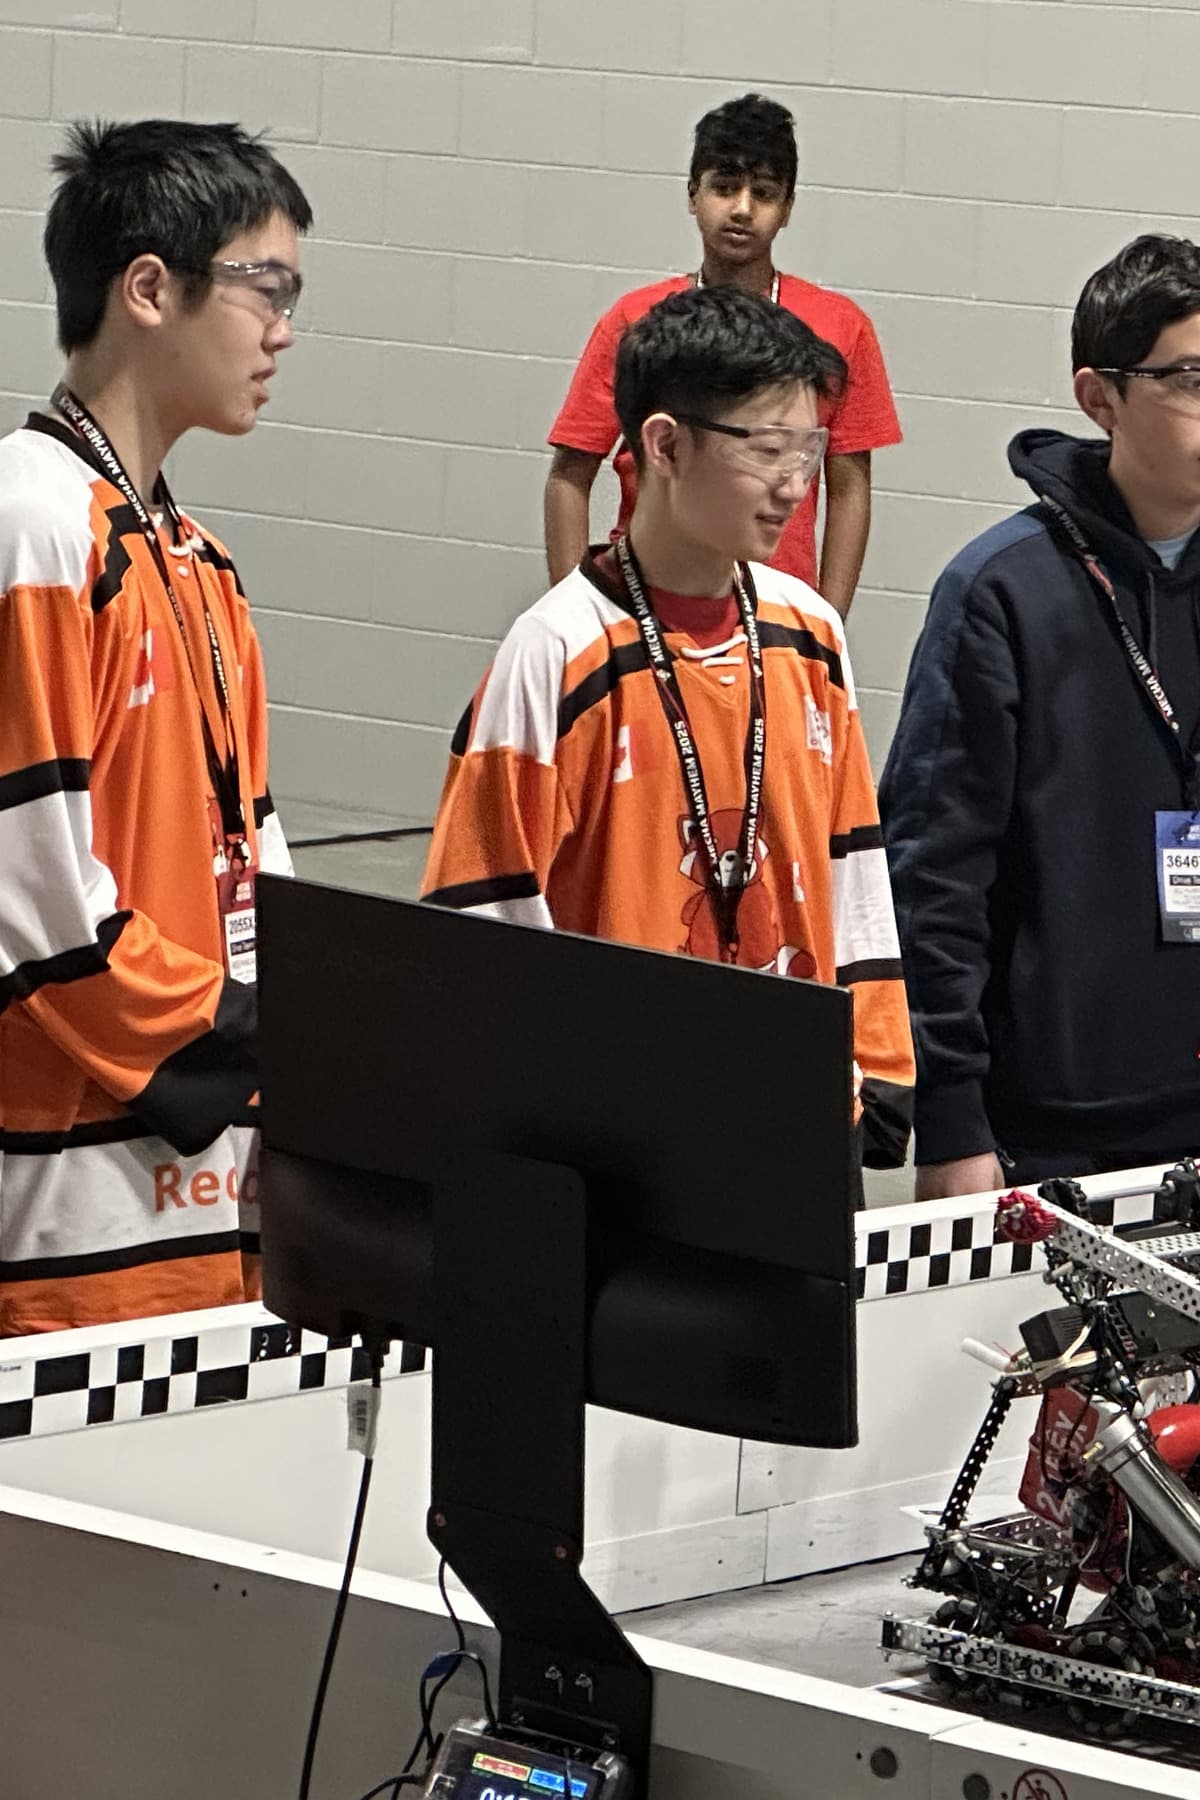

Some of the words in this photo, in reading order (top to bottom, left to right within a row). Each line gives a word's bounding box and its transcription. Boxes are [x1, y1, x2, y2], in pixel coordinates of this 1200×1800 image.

[79, 418, 121, 474] MAYHEM
[117, 475, 148, 523] MECHA
[623, 563, 648, 616] MAYHEM
[641, 617, 664, 663] MECHA
[1146, 675, 1174, 716] MECHA
[674, 721, 693, 755] 2025
[754, 718, 764, 752] 2025
[685, 756, 706, 816] MAYHEM
[750, 755, 763, 814] MAYHEM
[700, 818, 717, 864] MECHA
[746, 818, 756, 864] MECHA
